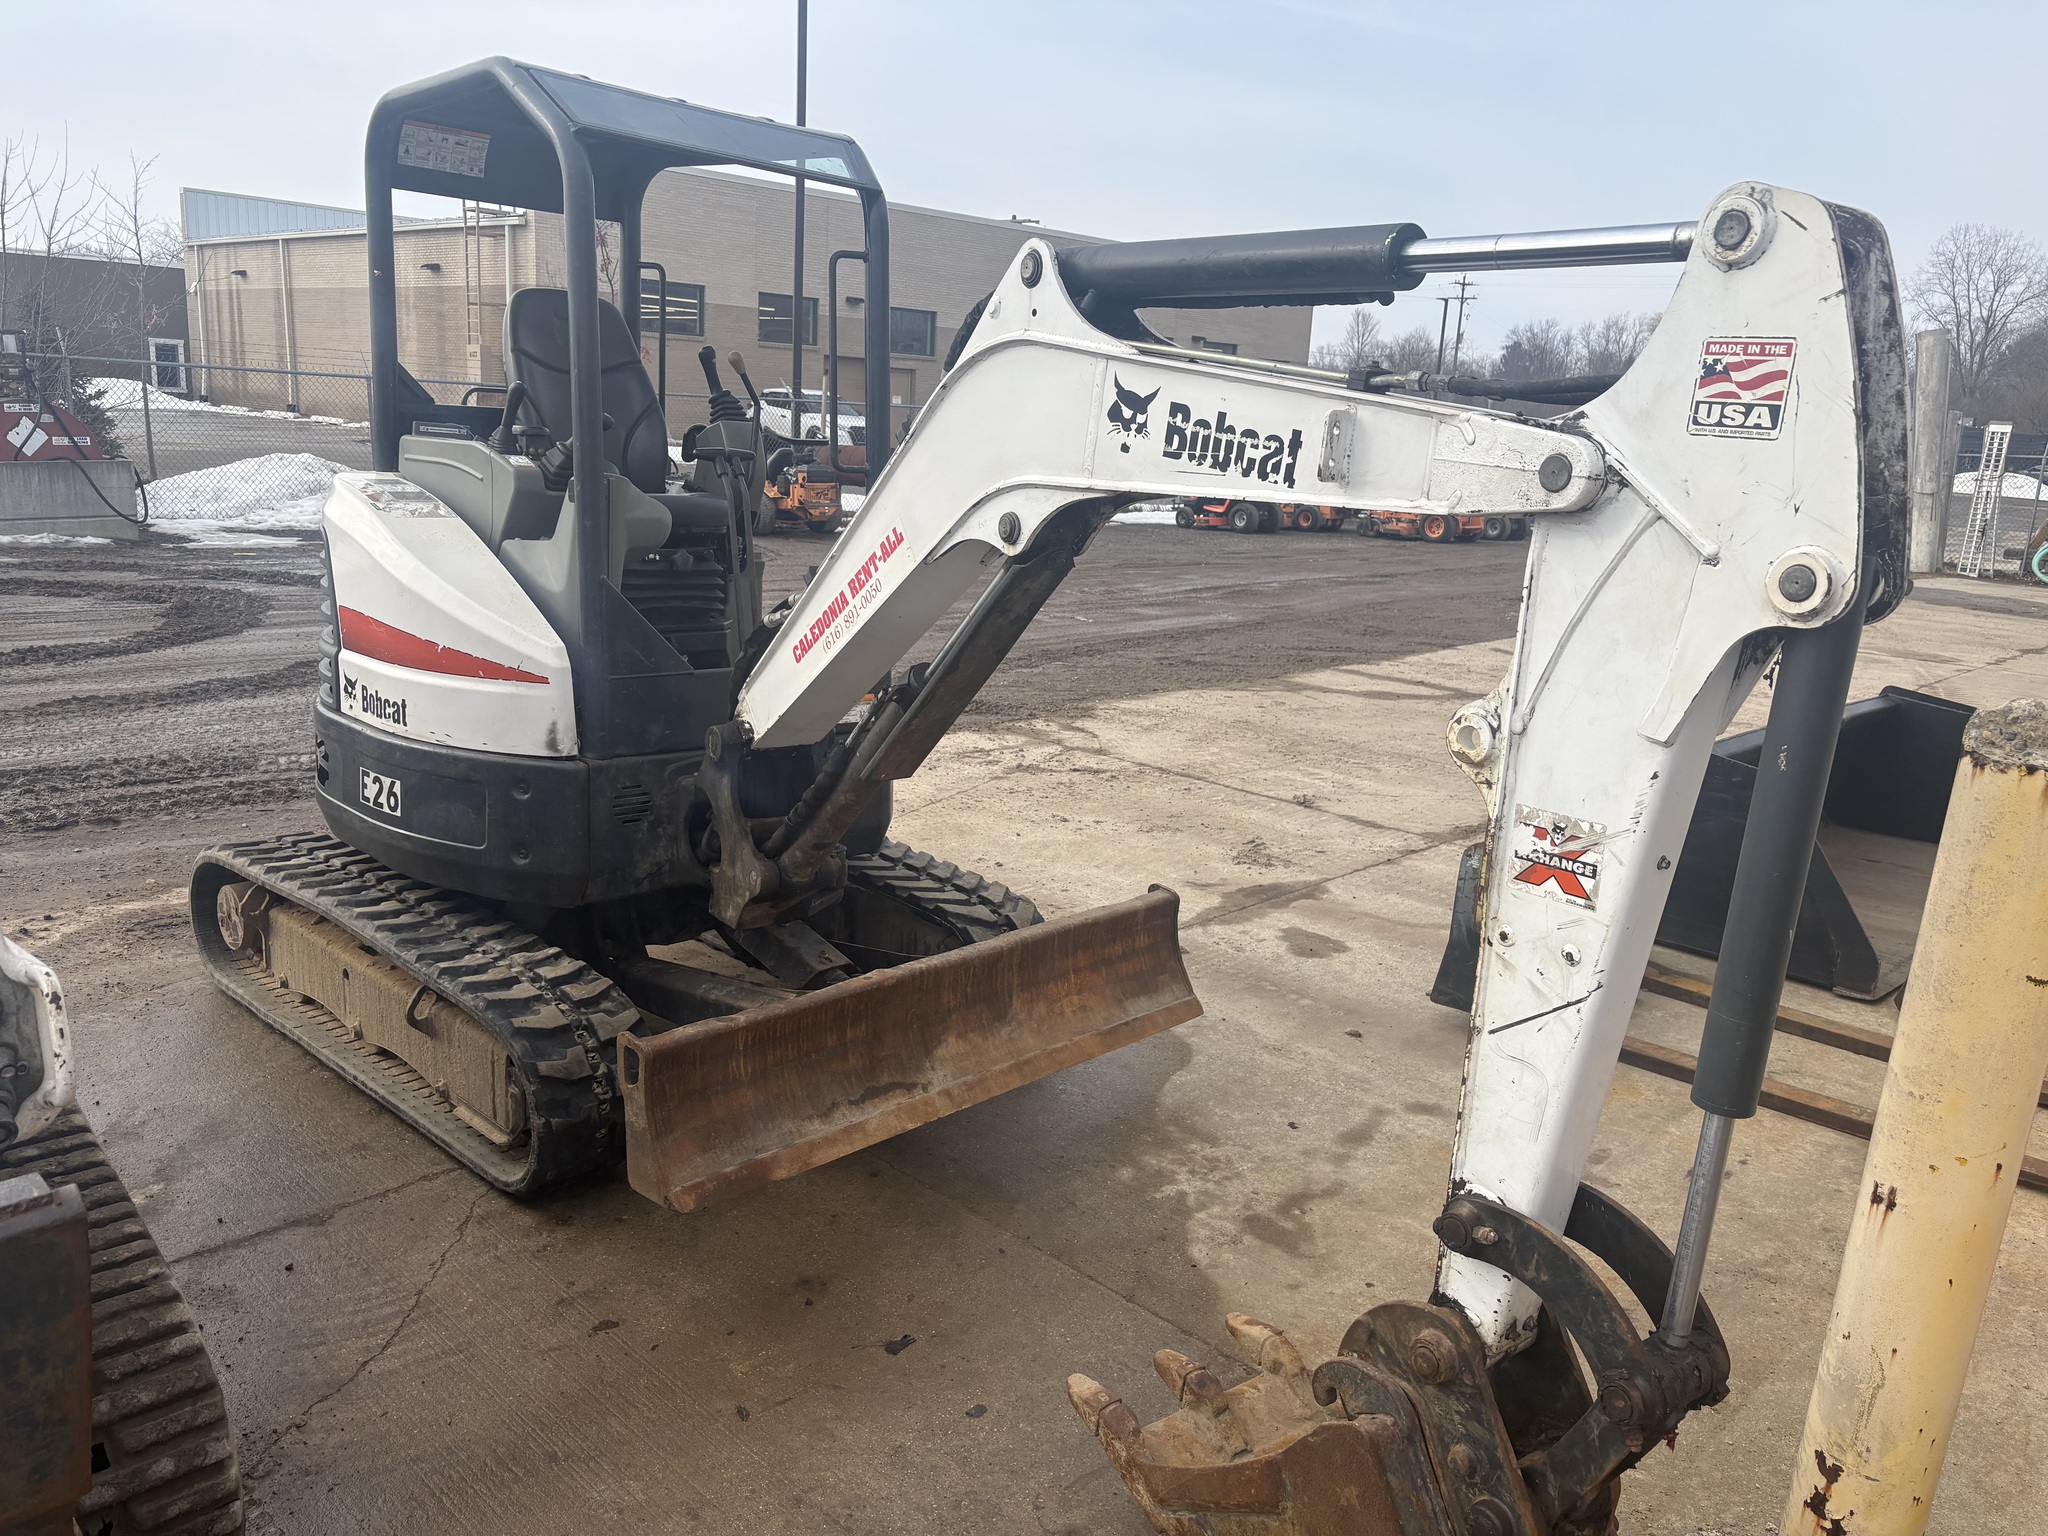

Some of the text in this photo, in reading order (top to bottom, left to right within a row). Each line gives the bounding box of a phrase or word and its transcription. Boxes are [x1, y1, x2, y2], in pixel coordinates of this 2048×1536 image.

[1708, 344, 1788, 355] MADE IN THE
[1696, 403, 1773, 428] USA
[1162, 401, 1303, 489] Bobcat
[792, 526, 905, 664] CALEDONIA RENT-ALL
[822, 578, 883, 655] (616) 891-0050
[361, 684, 408, 727] Bobcat
[360, 768, 399, 813] E26
